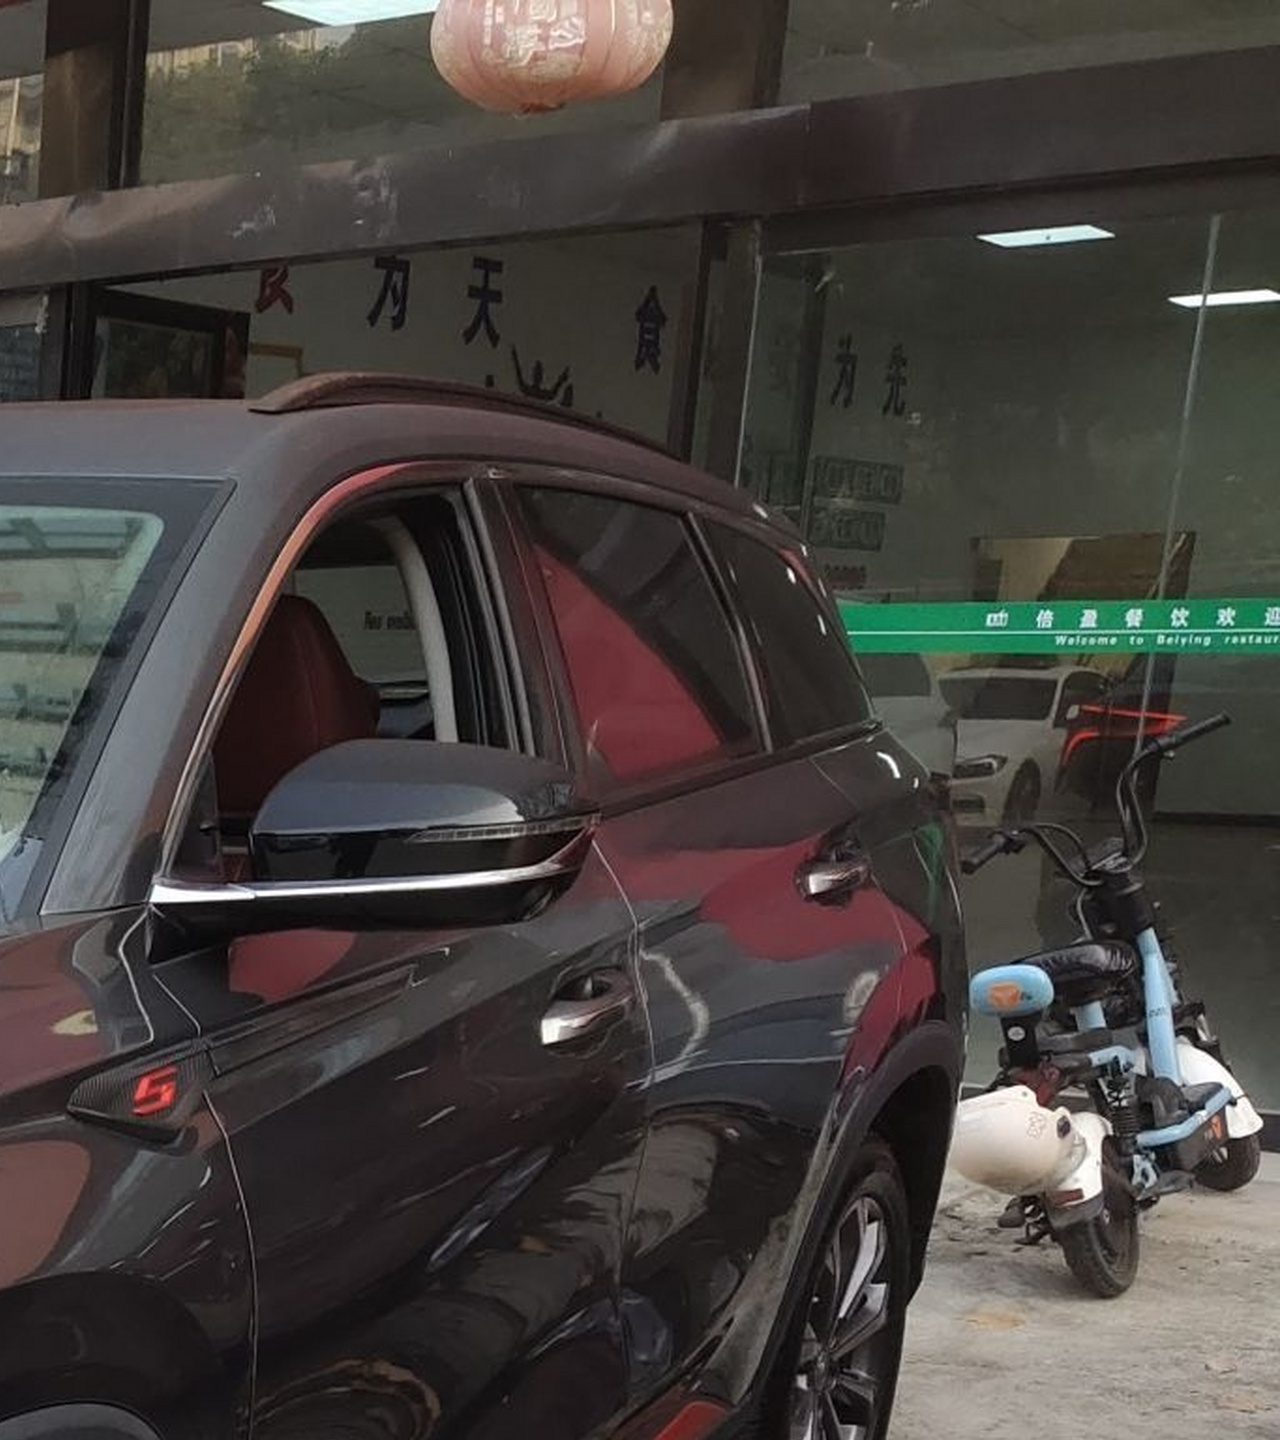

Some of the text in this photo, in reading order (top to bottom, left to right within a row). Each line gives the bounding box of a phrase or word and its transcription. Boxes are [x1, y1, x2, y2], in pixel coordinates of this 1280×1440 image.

[1054, 634, 1118, 646] Welcome
[1129, 635, 1145, 646] to
[1156, 633, 1212, 648] Beiying
